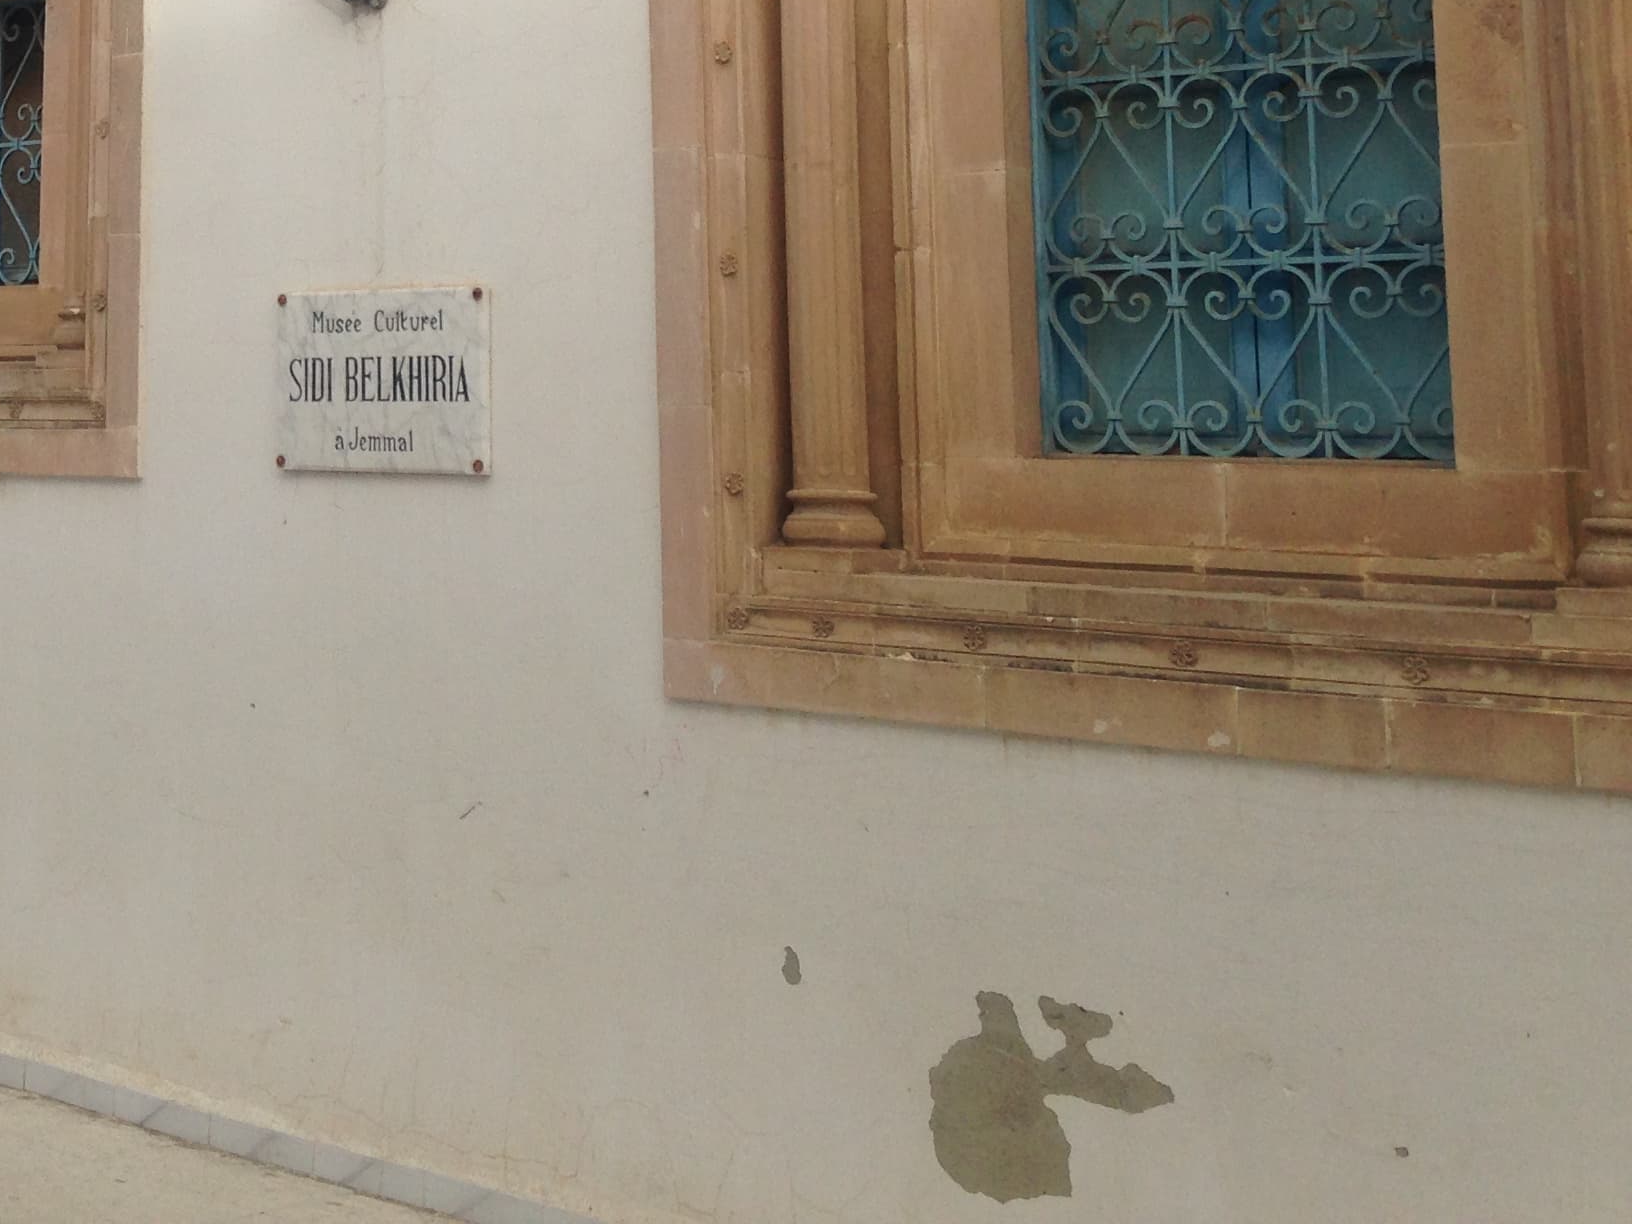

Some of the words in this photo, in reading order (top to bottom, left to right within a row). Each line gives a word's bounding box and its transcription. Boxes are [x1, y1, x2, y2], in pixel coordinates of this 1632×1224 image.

[374, 309, 444, 333] Culturel
[289, 357, 333, 402] SIDI
[345, 355, 470, 402] BELKHIRIA
[348, 427, 414, 452] Jemmal
